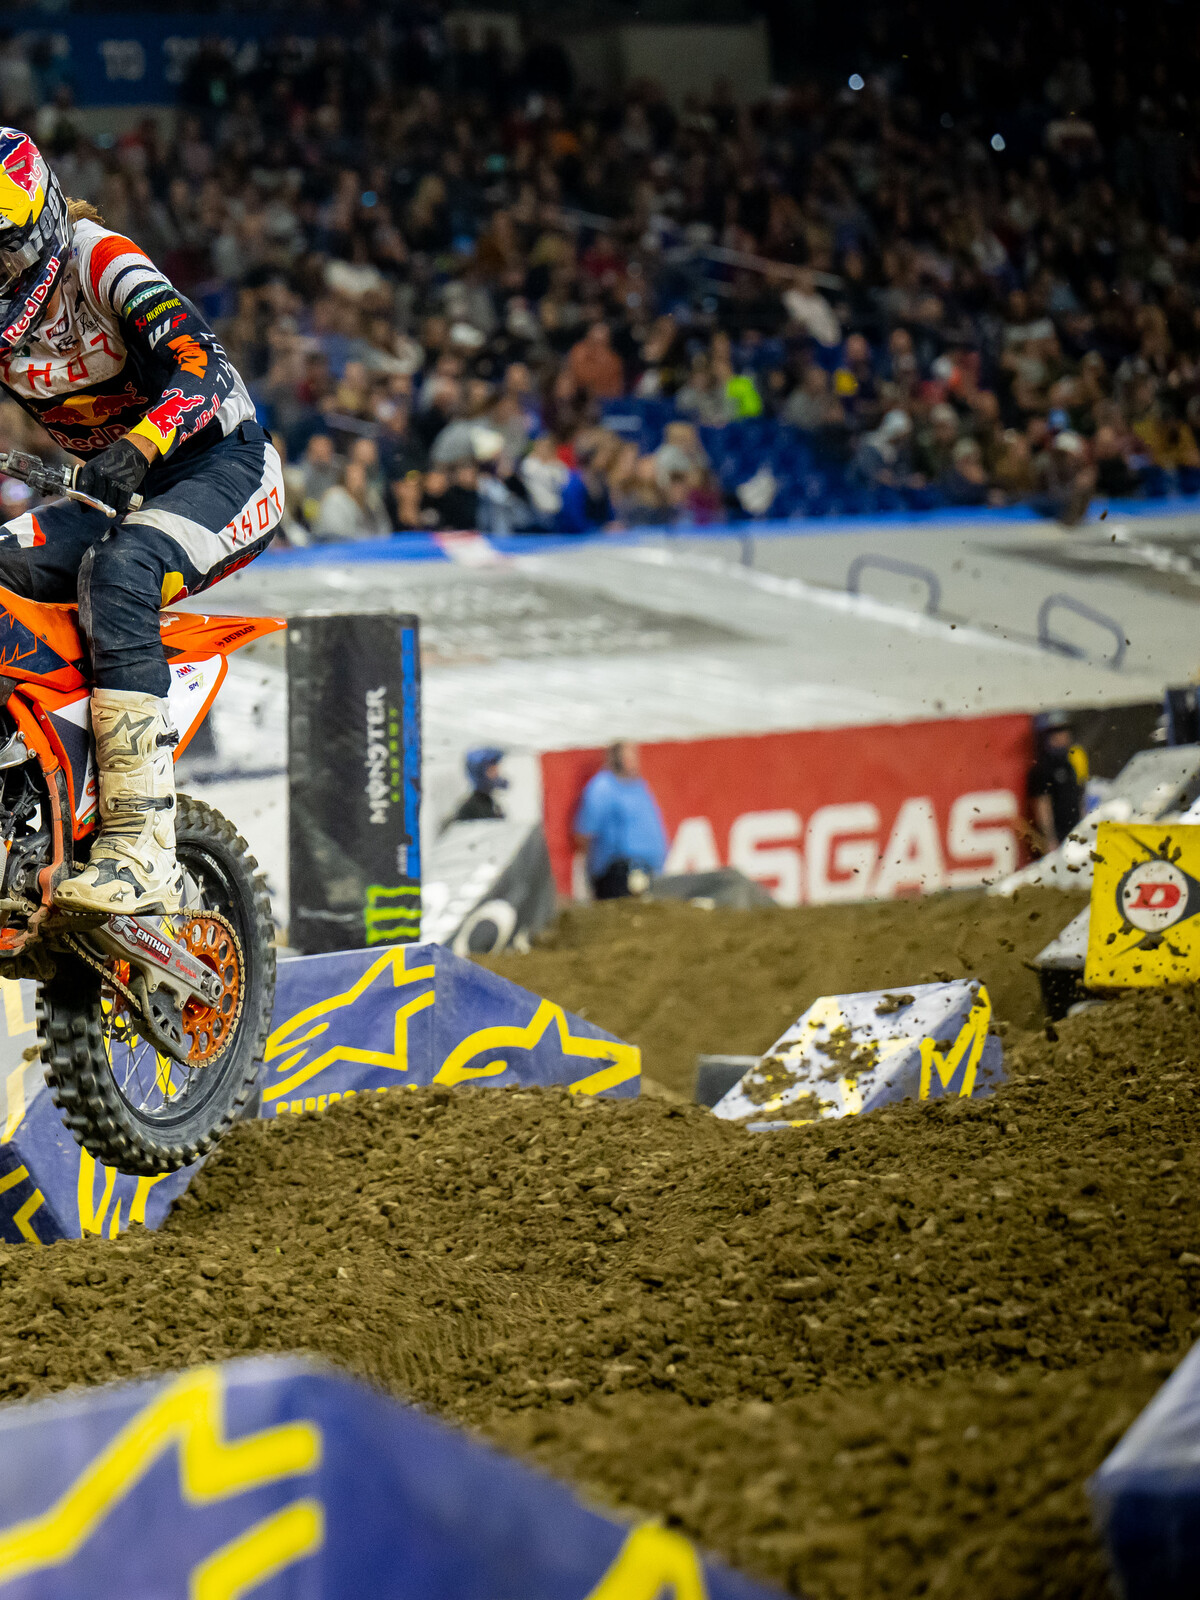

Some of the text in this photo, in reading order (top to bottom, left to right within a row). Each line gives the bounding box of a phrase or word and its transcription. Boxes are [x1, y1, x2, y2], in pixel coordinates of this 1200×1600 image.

[1, 298, 41, 346] Red
[31, 255, 61, 303] Bull
[222, 624, 256, 644] DUNLOP
[572, 788, 1020, 908] ASGAS
